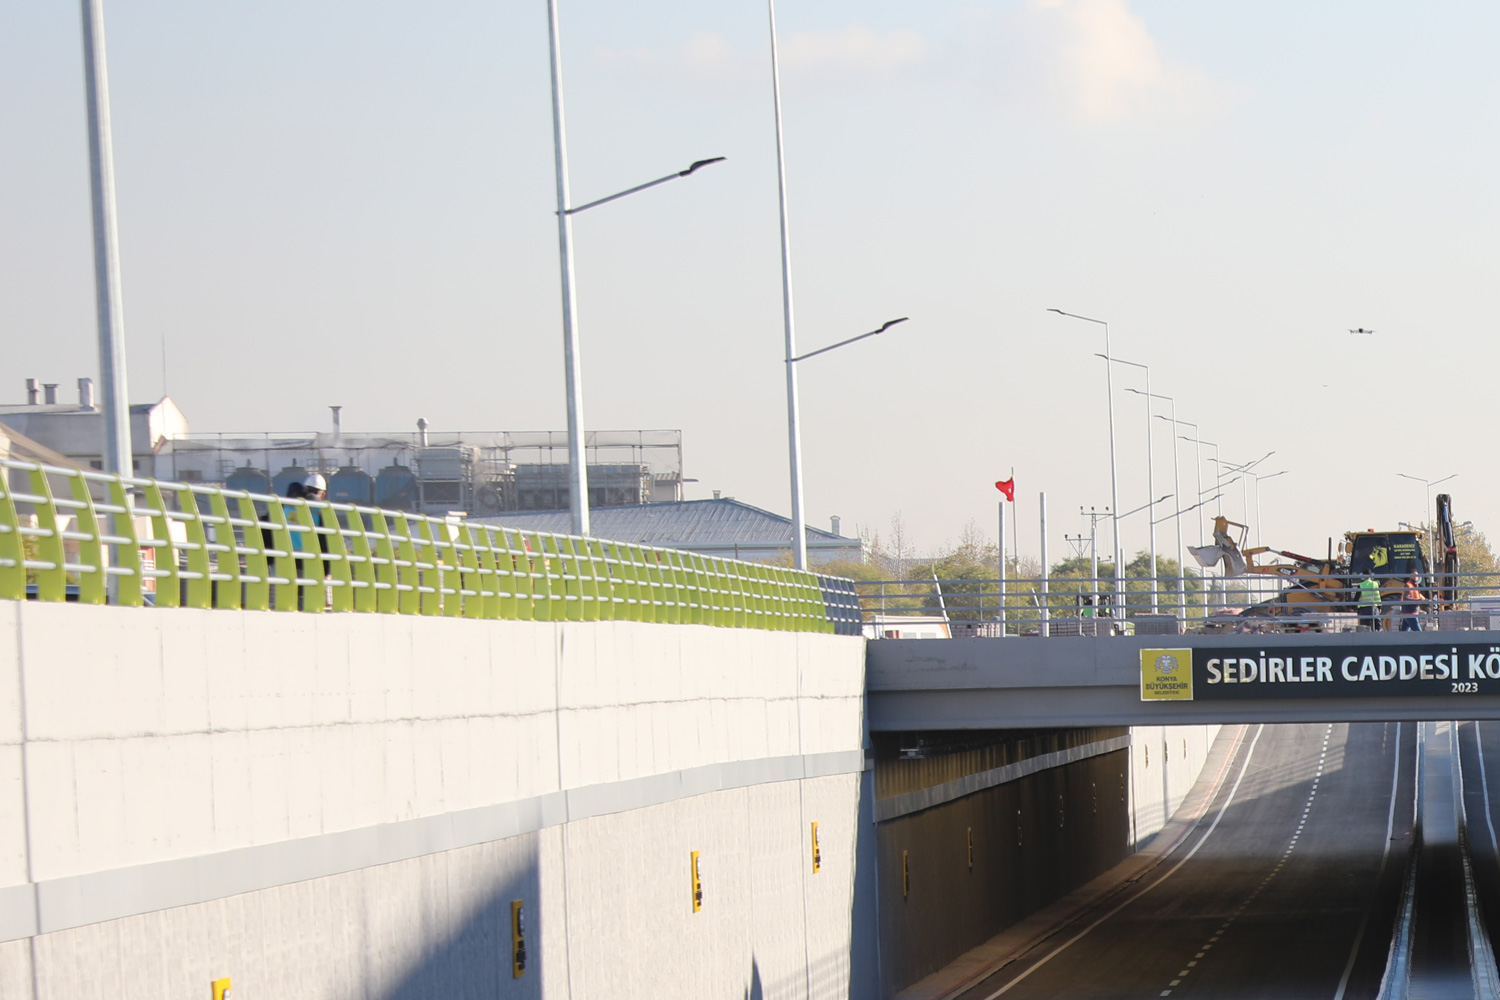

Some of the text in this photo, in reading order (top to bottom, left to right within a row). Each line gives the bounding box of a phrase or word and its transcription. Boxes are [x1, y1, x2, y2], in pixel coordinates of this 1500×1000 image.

[1207, 651, 1334, 684] SEDİRLER
[1341, 648, 1458, 682] CADDESİ
[1145, 682, 1188, 690] BÜYÜKŞEHİR
[1451, 683, 1479, 694] 2023
